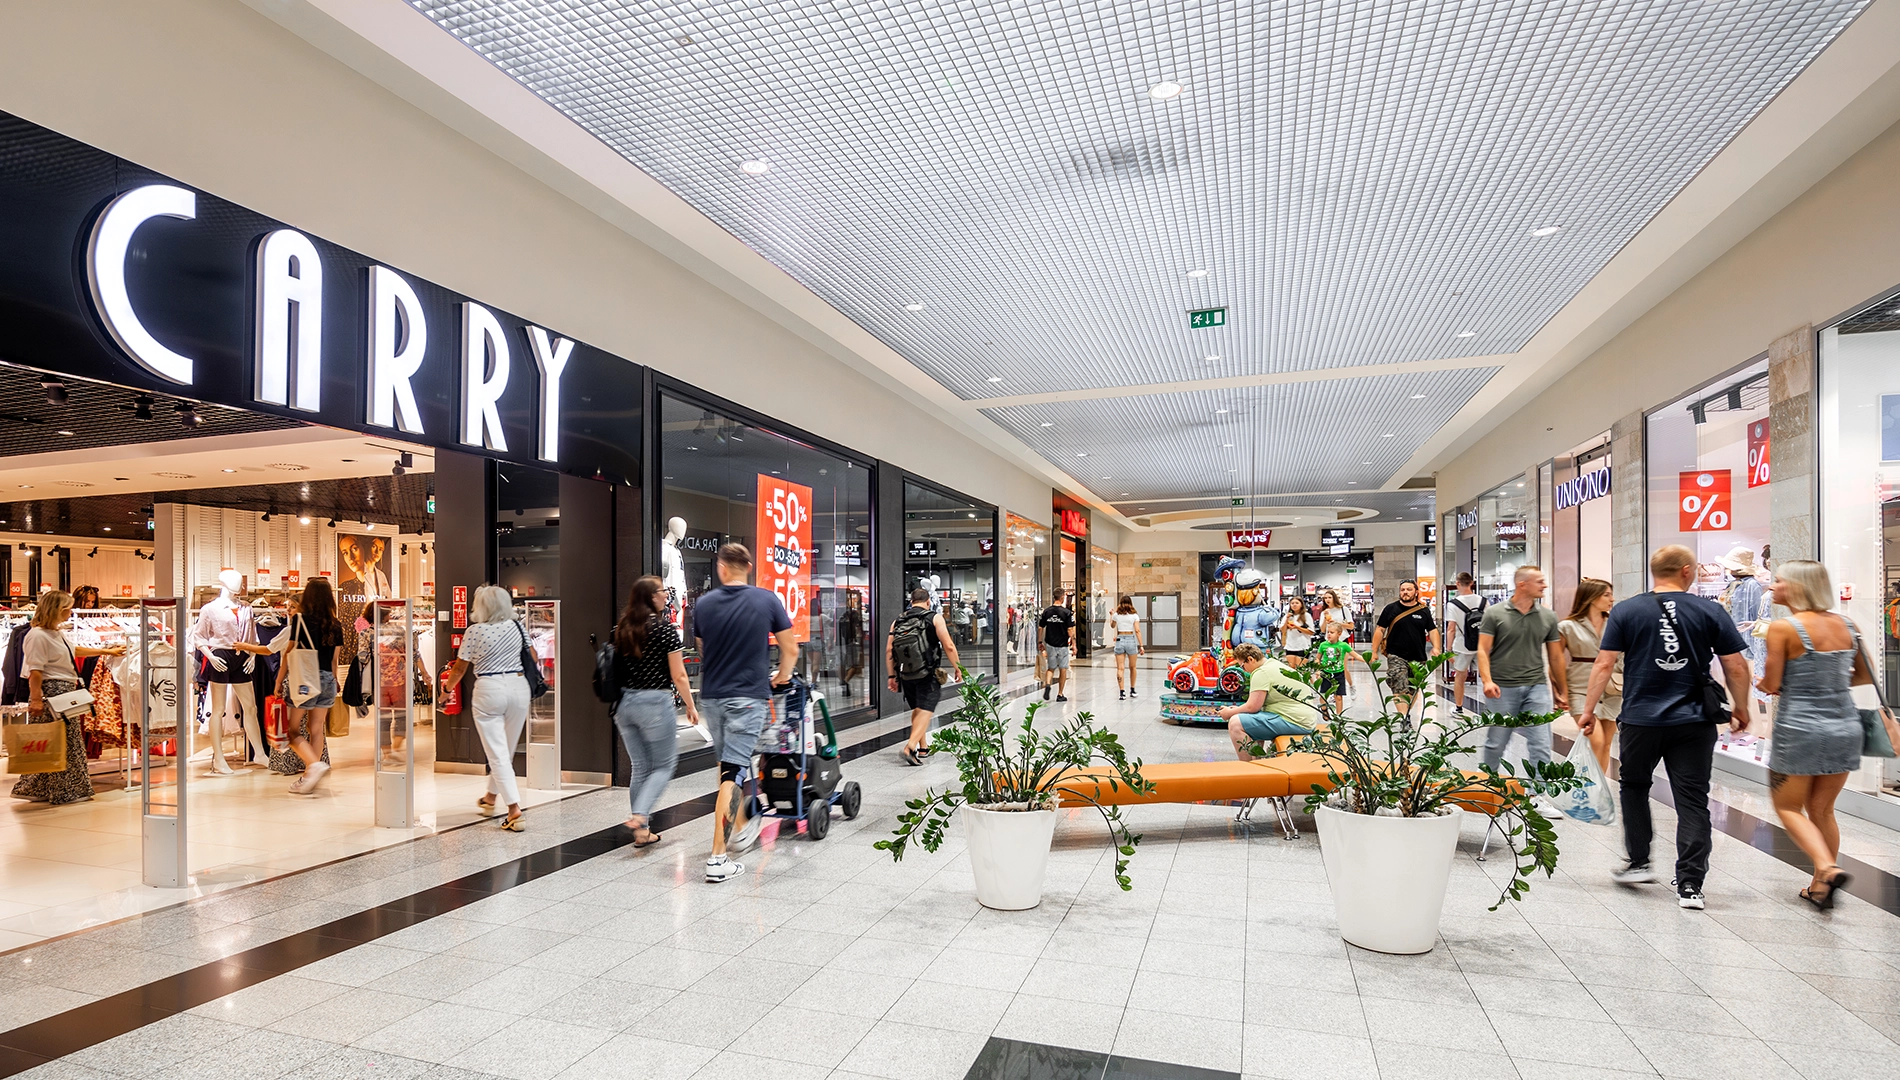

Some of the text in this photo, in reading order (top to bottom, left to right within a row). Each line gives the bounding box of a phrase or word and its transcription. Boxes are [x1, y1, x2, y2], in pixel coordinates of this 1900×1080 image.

[87, 184, 575, 463] CARRY
[1555, 467, 1610, 510] UNISONO
[1682, 494, 1728, 529] %
[775, 548, 785, 560] DO
[343, 594, 366, 603] EVERY
